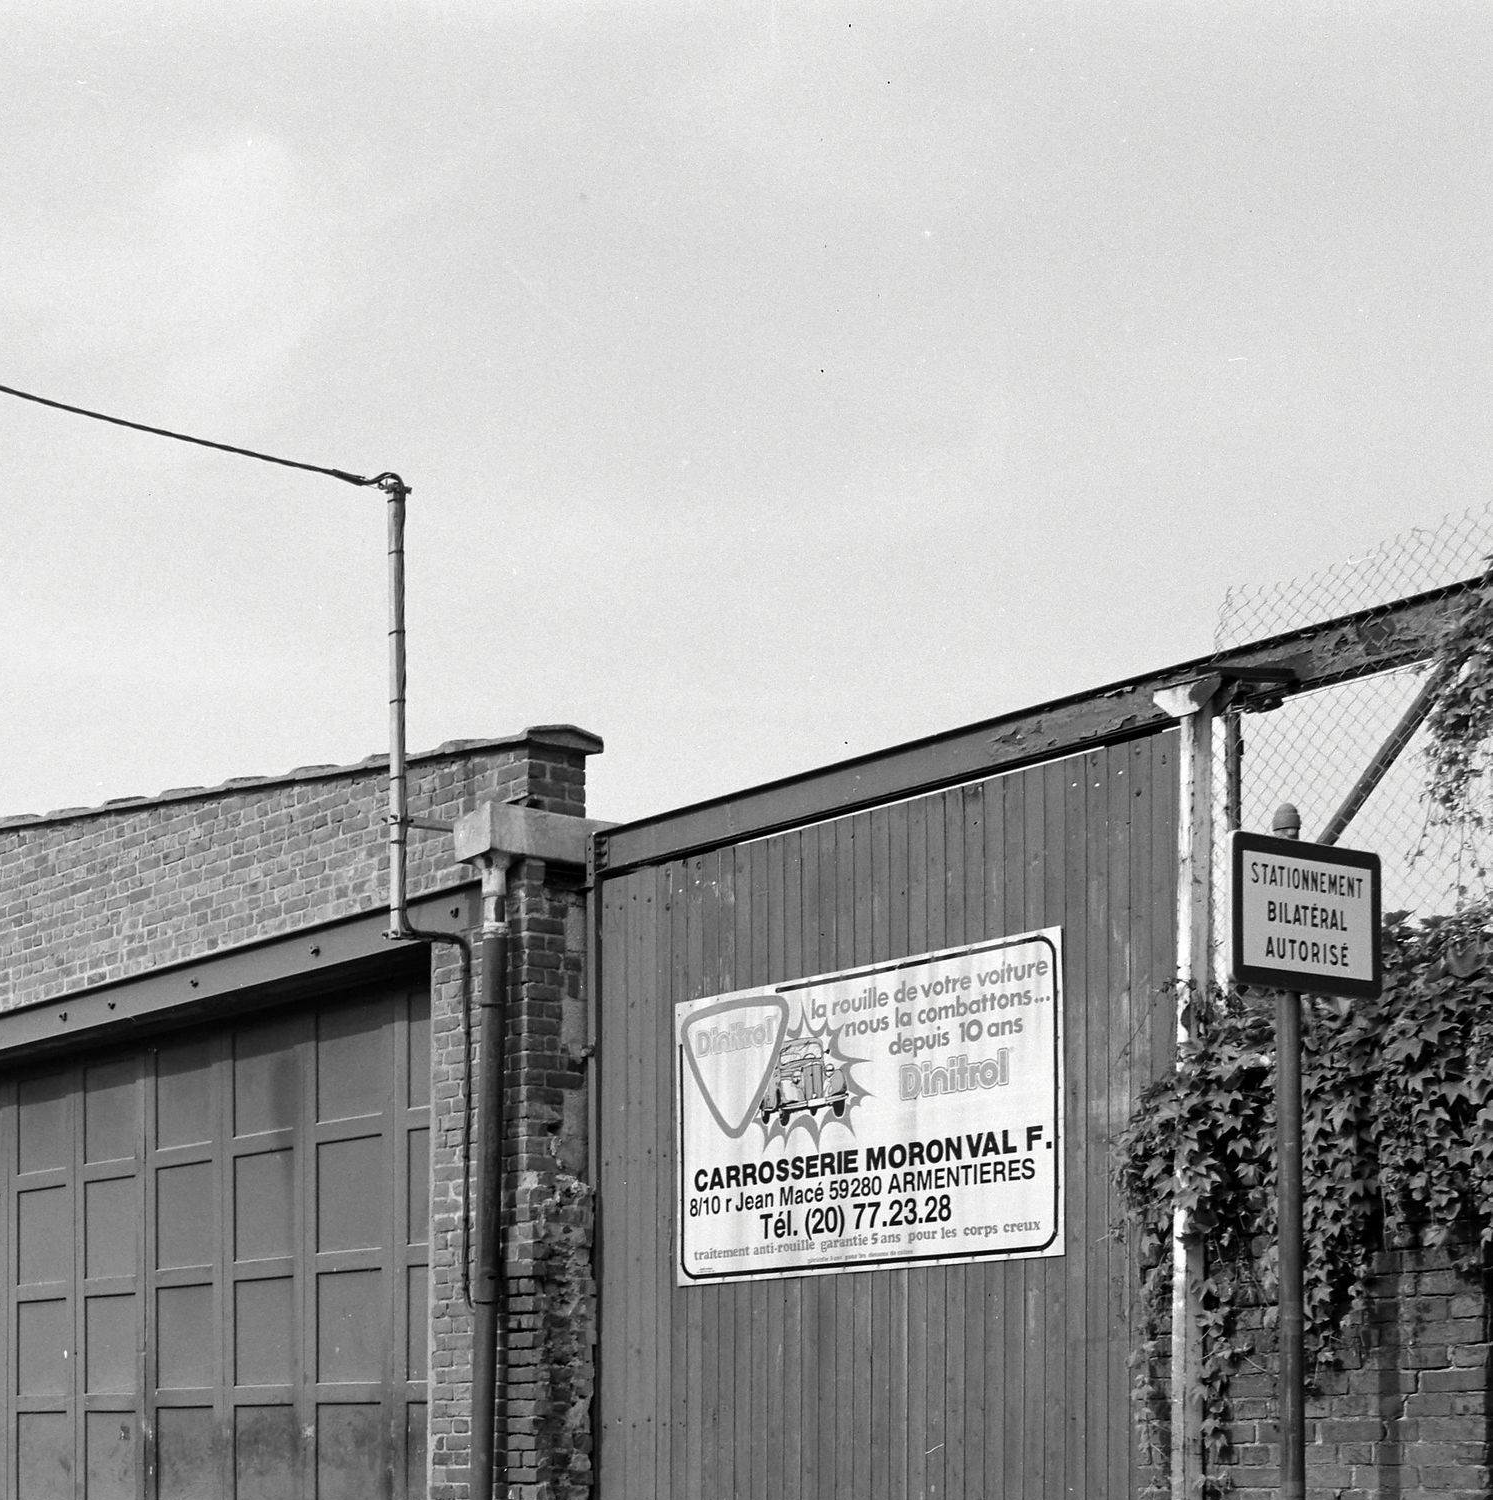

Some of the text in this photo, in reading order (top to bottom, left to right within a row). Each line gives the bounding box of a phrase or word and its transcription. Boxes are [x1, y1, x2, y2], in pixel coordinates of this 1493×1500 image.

[1251, 861, 1364, 899] STATIONNEMENT
[1267, 900, 1348, 932] BILATÉRAL
[1265, 936, 1349, 967] AUTORISÉ
[811, 960, 1049, 1020] la rouille de votre voiture
[845, 989, 1051, 1037] nous la combattons...
[888, 1017, 1024, 1058] depuis 10 ans
[899, 1047, 1009, 1101] Dinitrol
[694, 1125, 1052, 1192] CARROSSERIE MORONVAL F.
[689, 1158, 1036, 1217] 8/10 r Jean Macé 59280 ARMENTIERES
[693, 1220, 1041, 1261] traitement anti-rouille garantie 5 ans pour les corps creux
[759, 1194, 952, 1241] Tél. (20) 77.23.28
